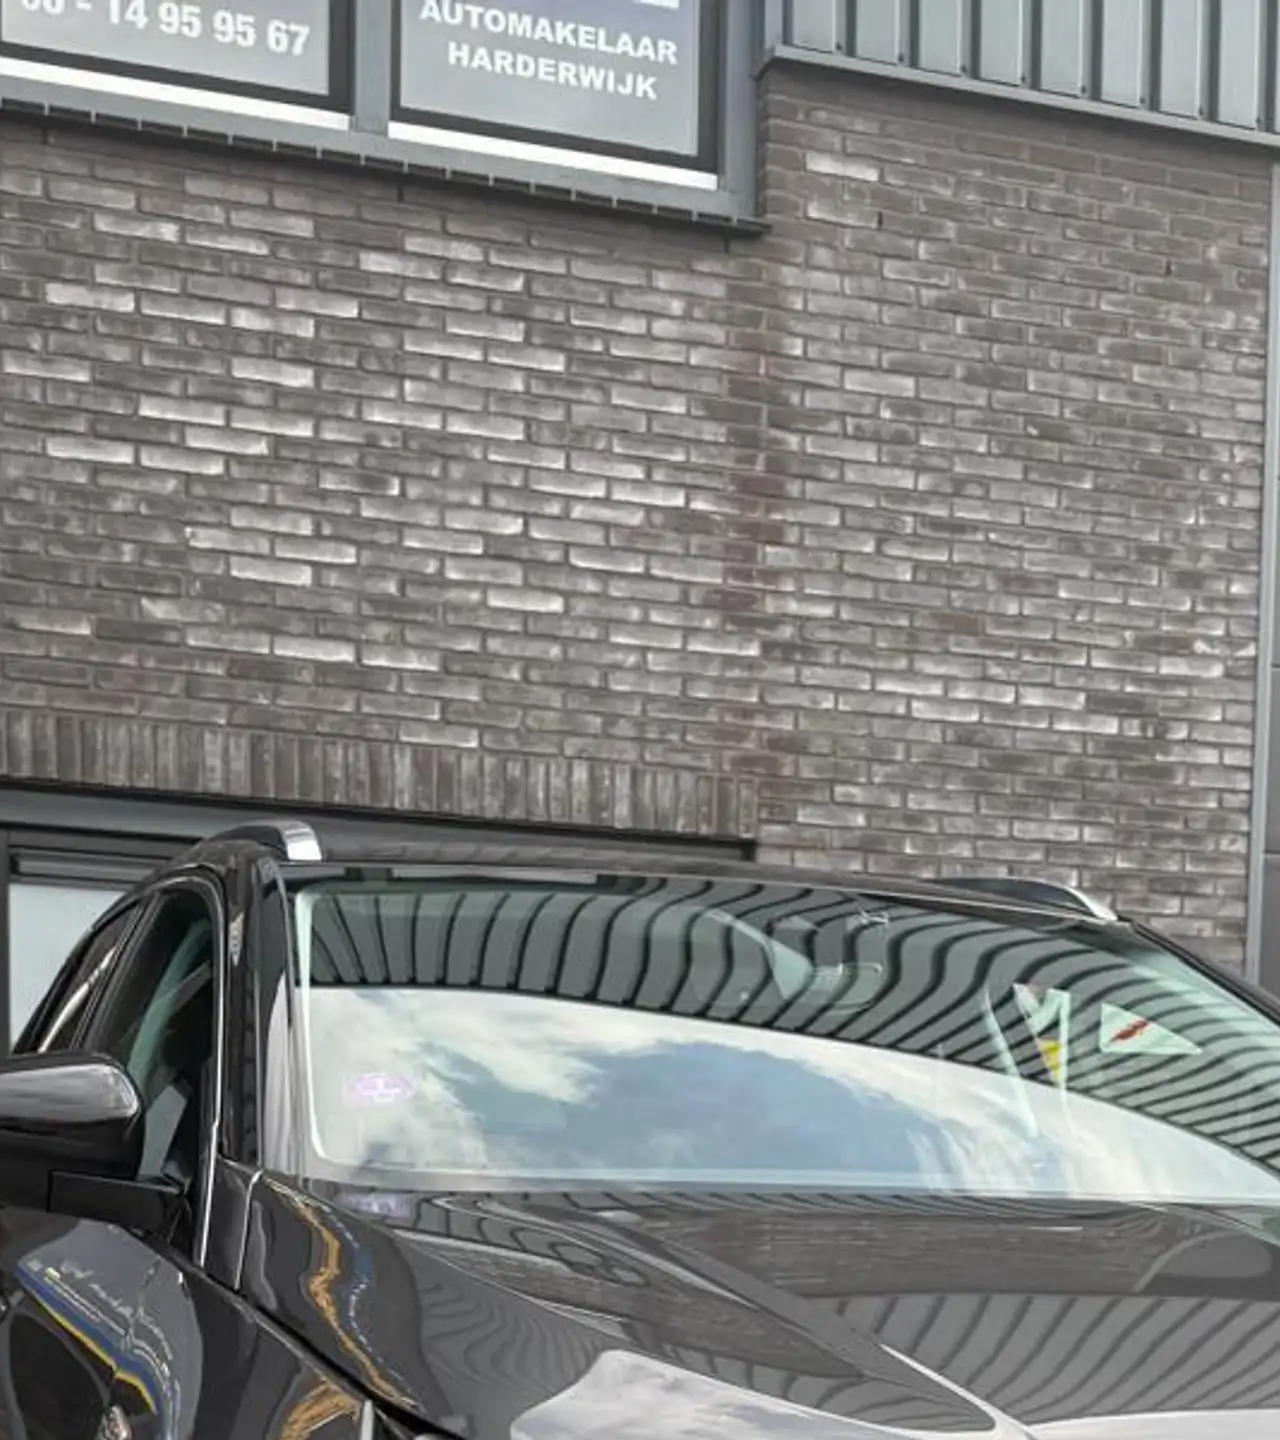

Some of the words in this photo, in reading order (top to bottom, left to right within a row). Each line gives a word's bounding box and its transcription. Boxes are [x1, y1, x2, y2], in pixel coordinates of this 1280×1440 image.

[109, 0, 149, 29] 14
[159, 4, 202, 38] 95
[213, 9, 257, 47] 95
[268, 18, 310, 56] 67
[419, 0, 678, 65] AUTOMAKELAAR
[447, 42, 658, 100] HARDERWIJK
